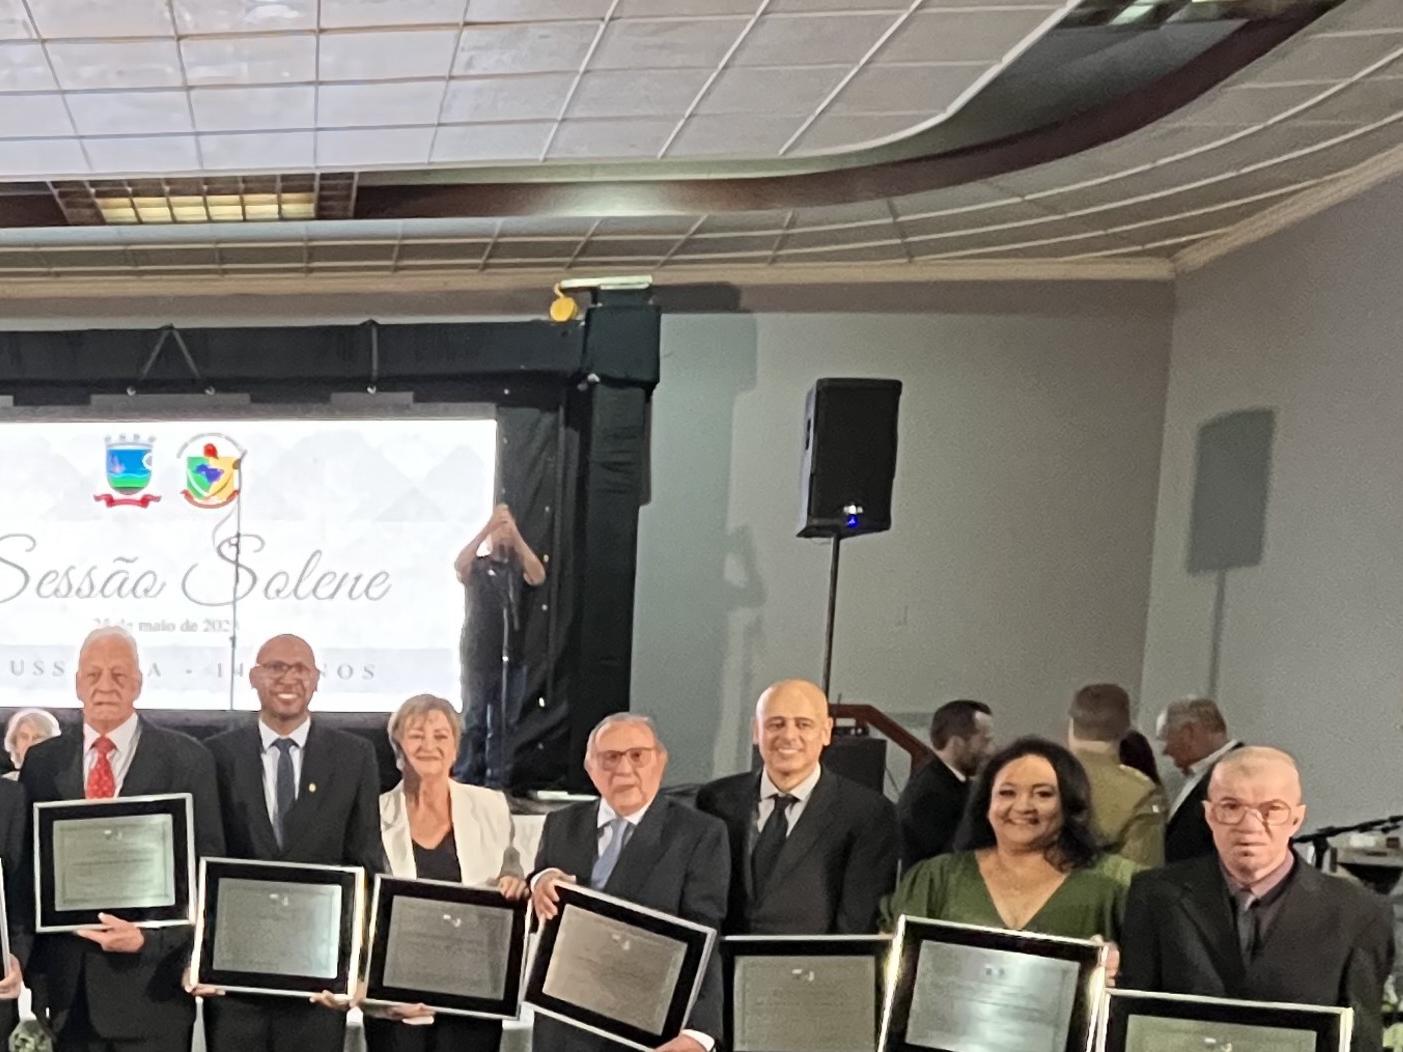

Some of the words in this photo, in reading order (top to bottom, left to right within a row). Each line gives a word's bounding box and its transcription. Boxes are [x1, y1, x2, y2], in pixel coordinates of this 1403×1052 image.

[181, 534, 392, 607] Solene
[138, 619, 176, 632] maio
[180, 619, 198, 632] de
